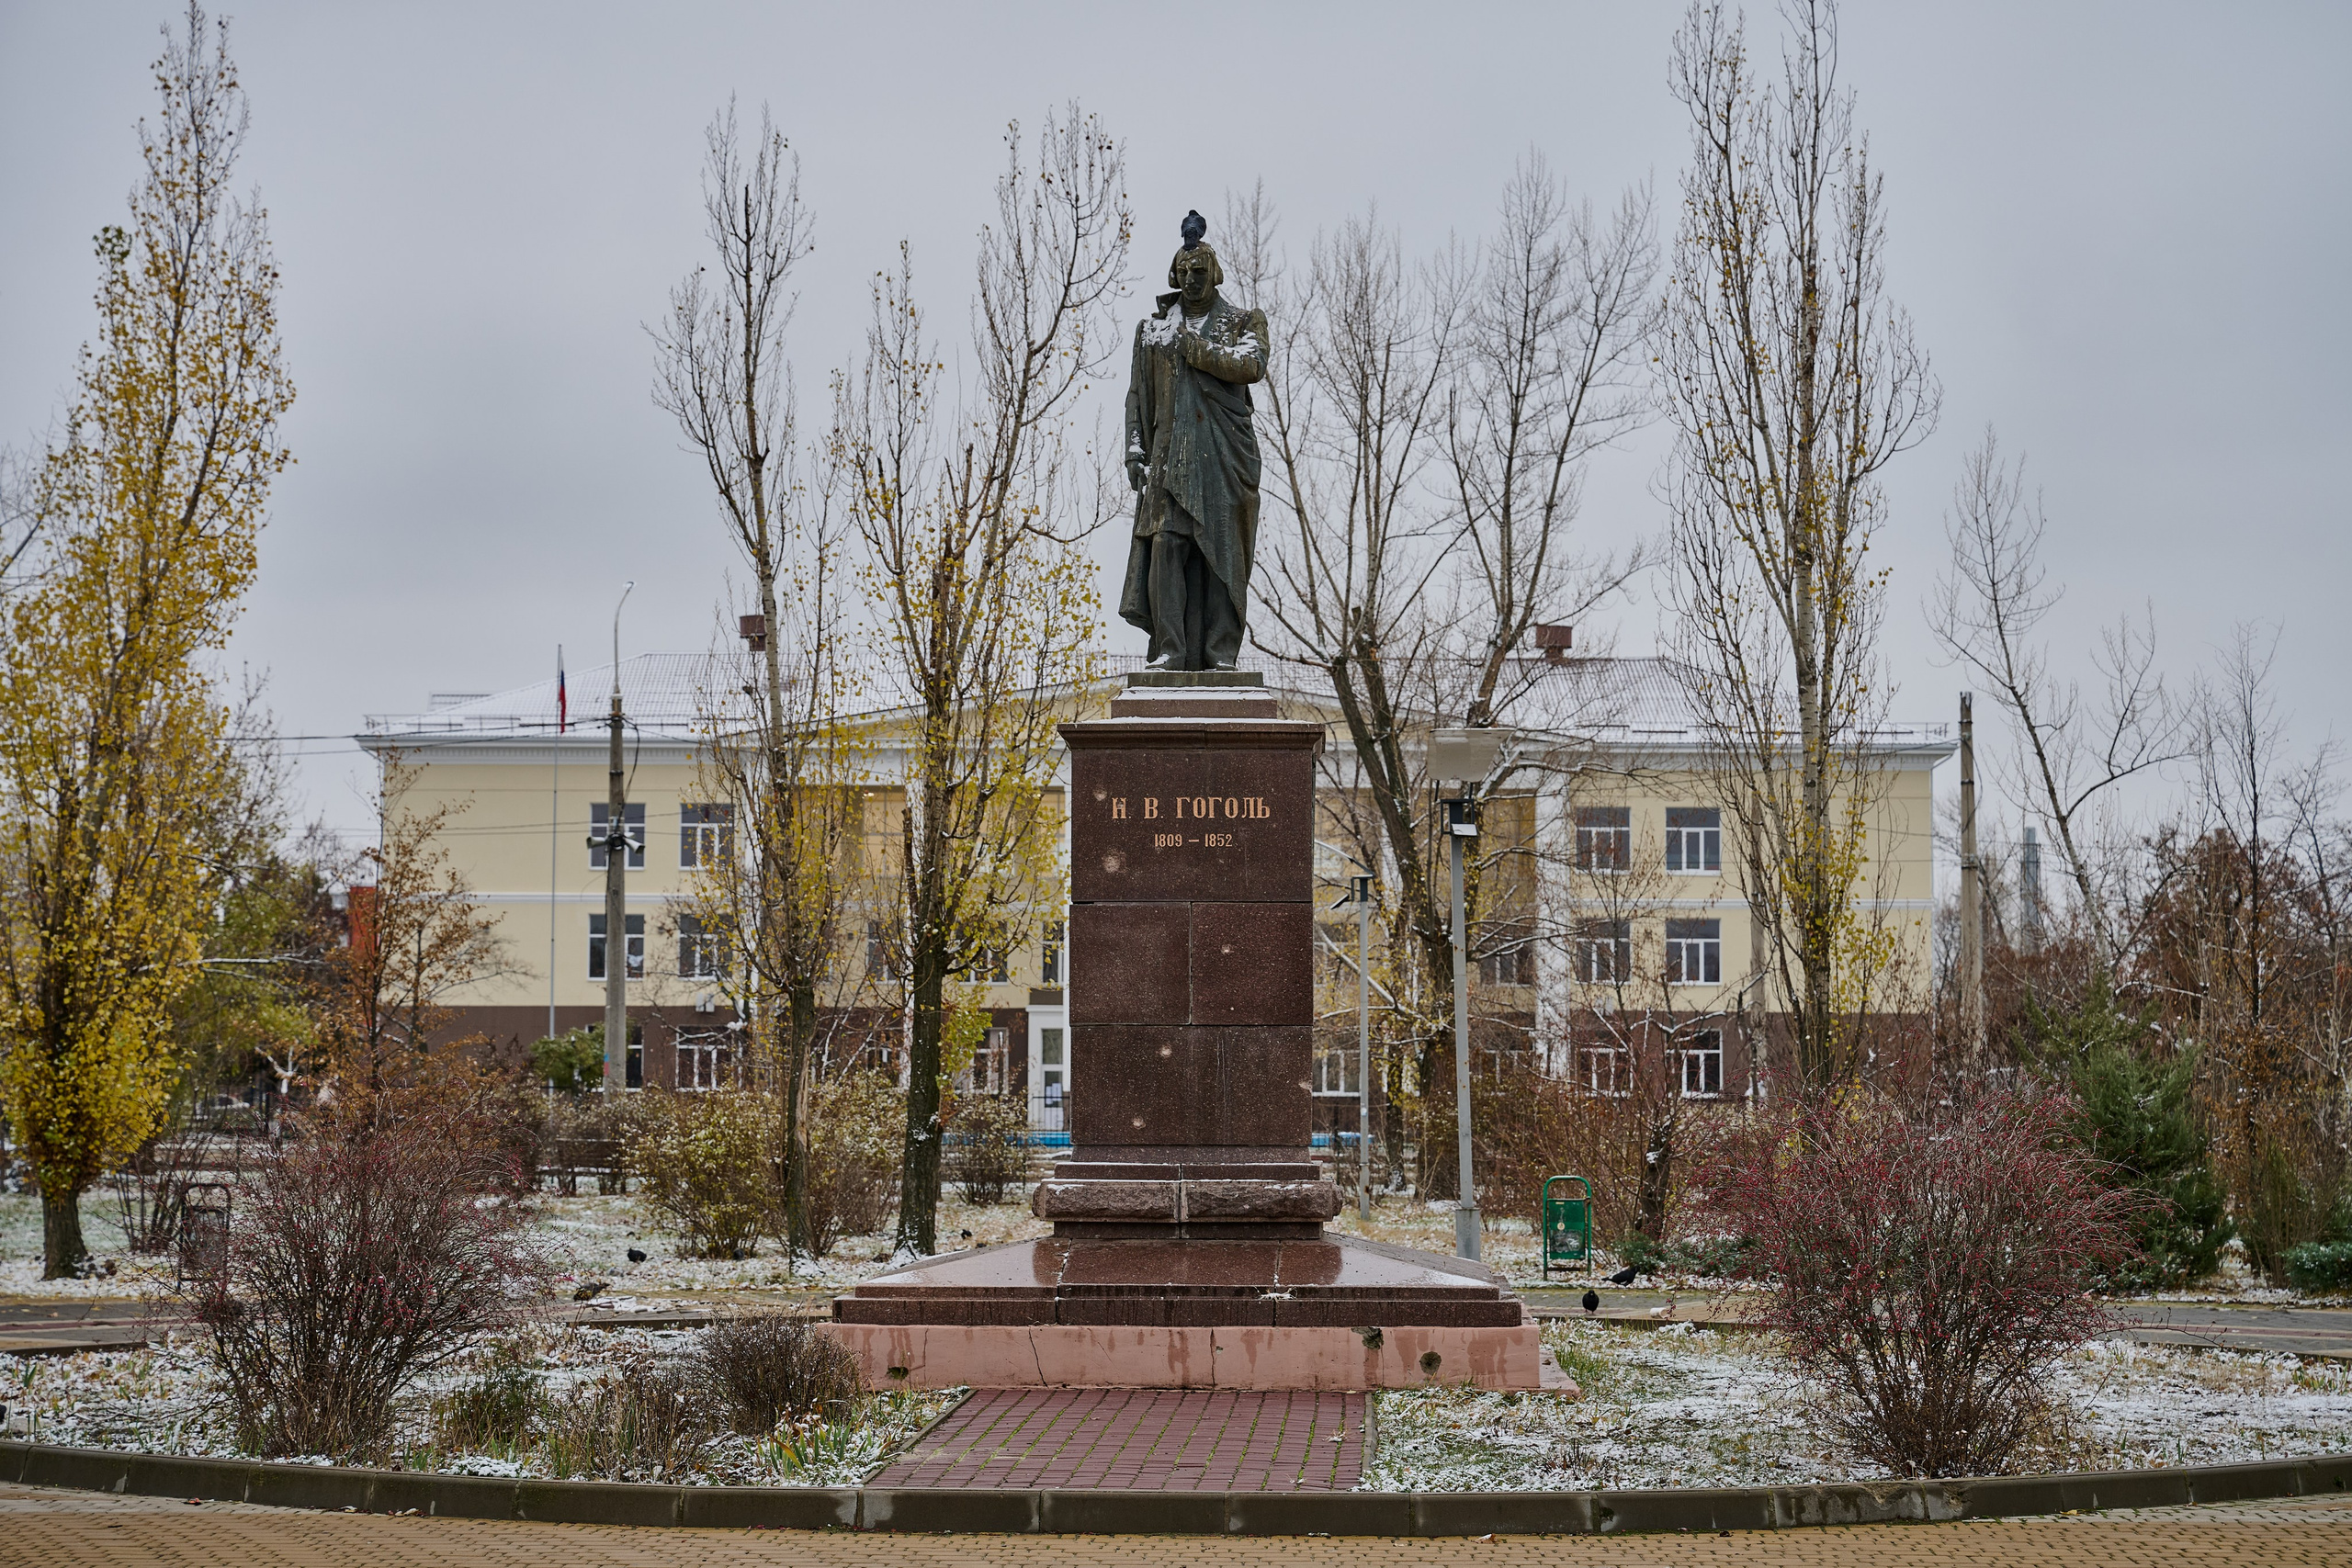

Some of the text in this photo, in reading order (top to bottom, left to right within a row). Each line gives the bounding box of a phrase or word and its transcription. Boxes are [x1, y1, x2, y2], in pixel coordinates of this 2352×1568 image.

[1112, 796, 1271, 819] Н. В. ГОГОЛЬ
[1154, 833, 1182, 848] 1809
[1204, 833, 1233, 848] 1852
